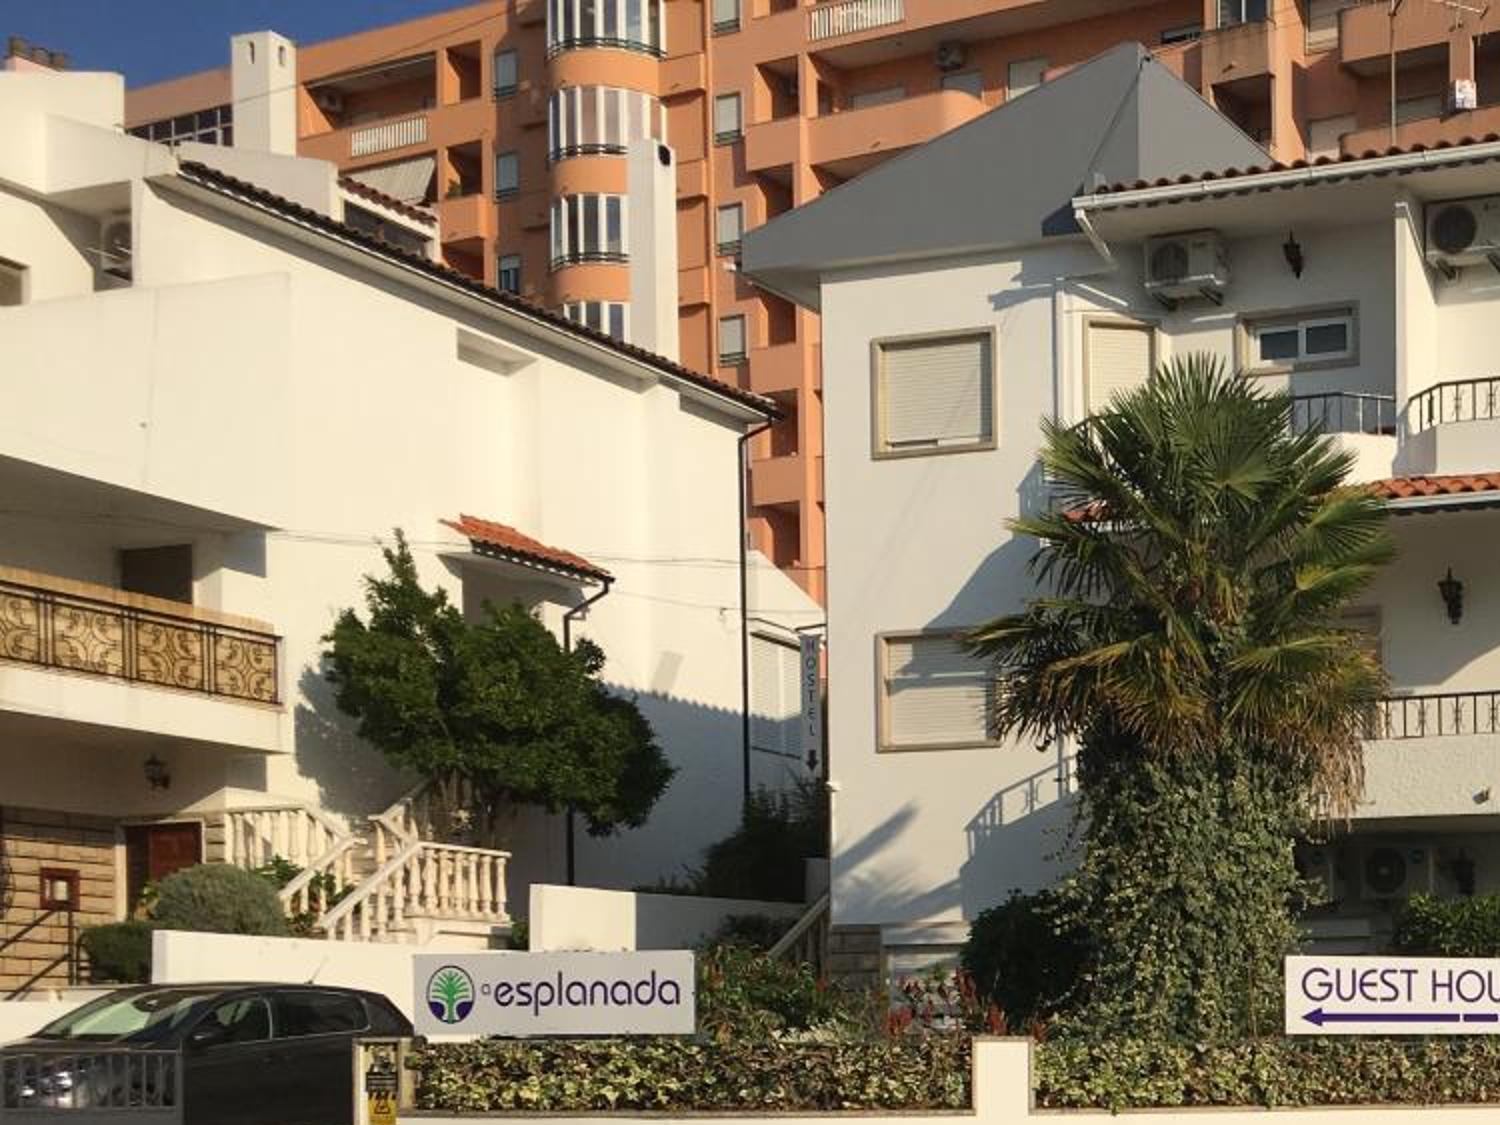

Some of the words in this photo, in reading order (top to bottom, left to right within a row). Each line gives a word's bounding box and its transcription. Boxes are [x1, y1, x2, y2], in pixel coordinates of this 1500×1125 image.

[804, 638, 816, 737] HOSTEL
[494, 970, 681, 1017] esplanada
[1301, 967, 1419, 1002] GUEST
